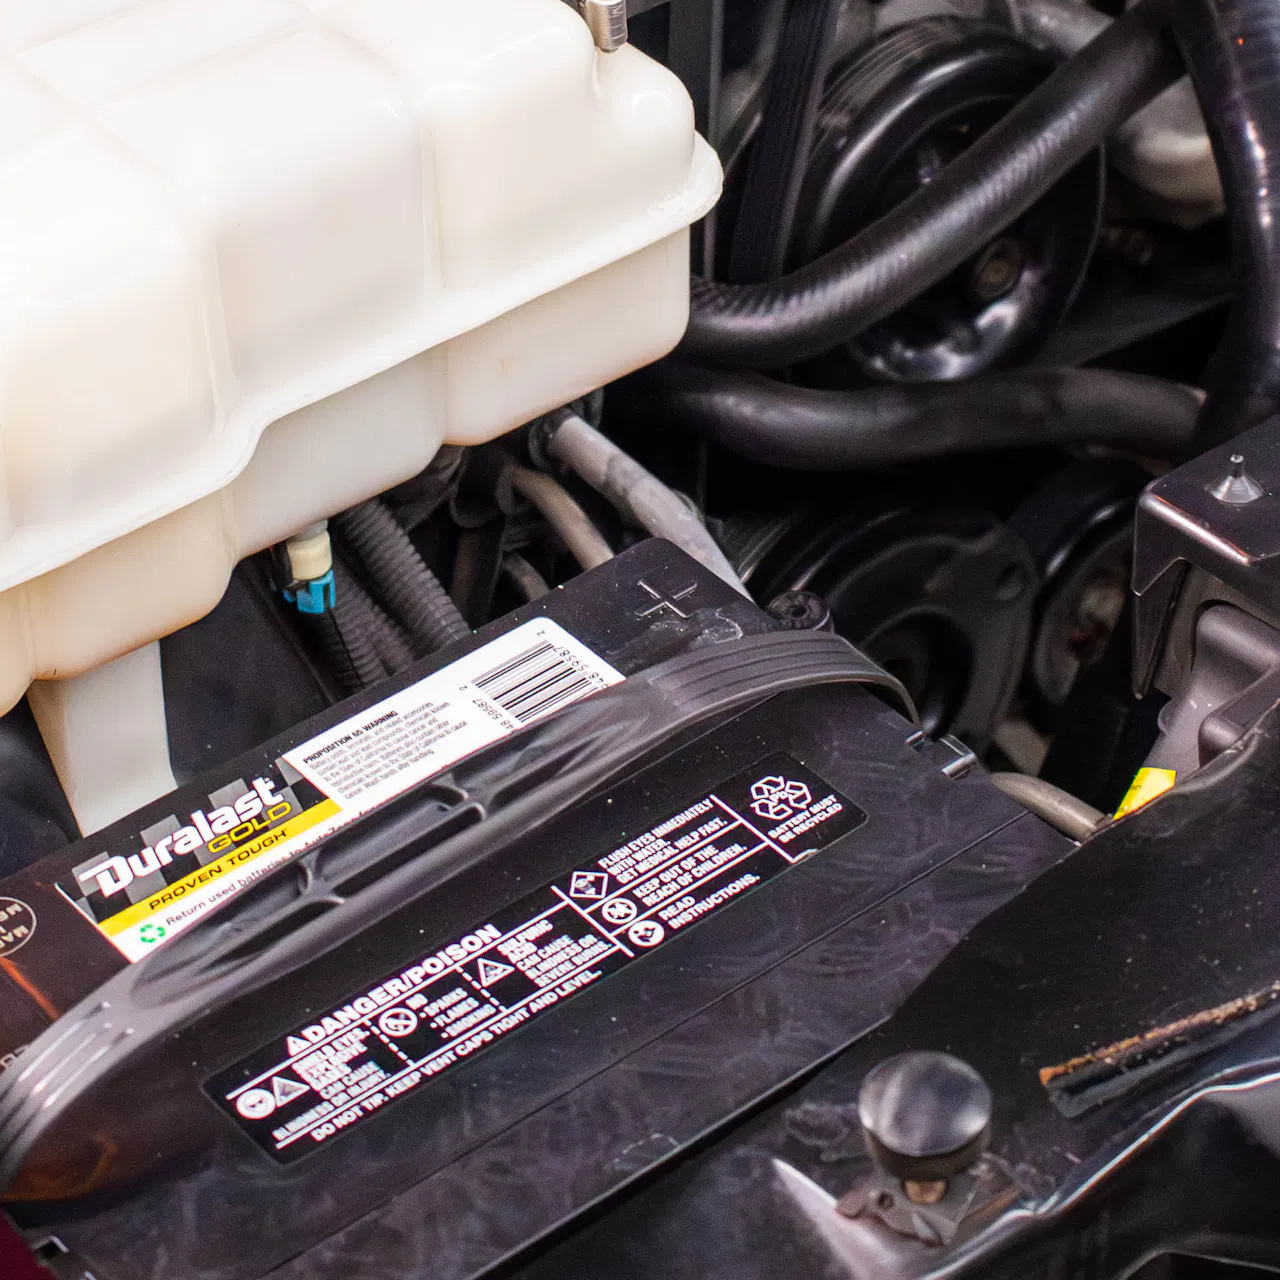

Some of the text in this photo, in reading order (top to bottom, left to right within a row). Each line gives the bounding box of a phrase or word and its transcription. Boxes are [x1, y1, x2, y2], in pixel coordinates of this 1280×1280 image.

[301, 709, 398, 764] PROPOSITION 65 WARNING
[78, 772, 289, 902] Duralast
[204, 799, 296, 855] GOLD
[596, 797, 716, 869] FLUSH EYES IMMEDIATELY
[765, 793, 840, 839] BATTERY MUST
[777, 801, 845, 843] BE RECYCLED
[146, 828, 287, 911] PROVEN TOUGH
[605, 836, 671, 876] WITH WATER.
[614, 815, 728, 884] GET MEDICAL HELP FAST.
[630, 844, 720, 899] KEEP OUT OF THE
[640, 841, 748, 907] REACH OF CHILDREN.
[166, 899, 205, 926] Return
[209, 884, 236, 903] used
[656, 894, 698, 921] READ
[666, 870, 763, 929] INSTRUCTIONS.
[495, 918, 555, 956] SULFURIC
[505, 941, 539, 964] ACID
[514, 933, 575, 971] CAN CAUSE
[524, 933, 600, 979] BLINDNESS OR
[299, 922, 503, 1044] DANGER/POISON
[533, 938, 613, 987] SEVERE BURNS.
[404, 992, 430, 1010] NO
[420, 986, 470, 1017] SPARKS
[432, 996, 481, 1027] FLAMES
[307, 965, 605, 1140] DO NOT TIP. KEEP VENT CAPS TIGHT AND LEVEL.
[317, 1060, 381, 1099] CAN CAUSE
